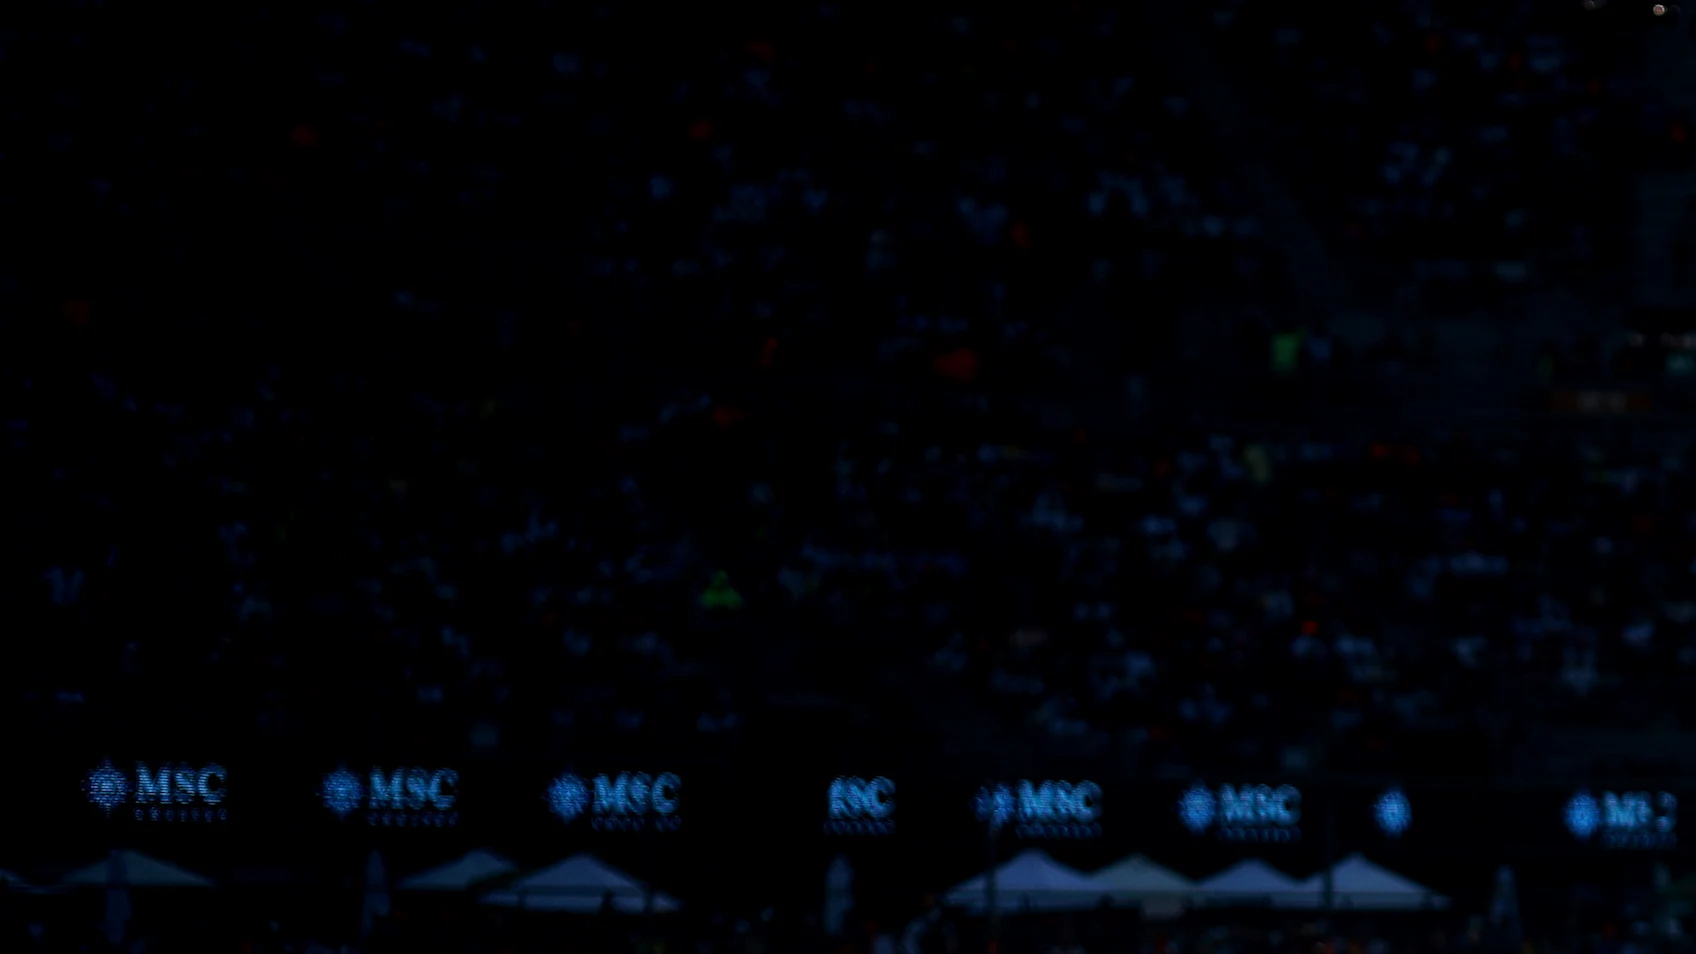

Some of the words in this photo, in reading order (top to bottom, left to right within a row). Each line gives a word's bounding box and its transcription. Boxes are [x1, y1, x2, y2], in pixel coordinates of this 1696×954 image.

[134, 760, 228, 805] MSC
[371, 765, 460, 810] MSC
[592, 771, 682, 816] MSC
[1016, 779, 1103, 822] MSC
[1218, 783, 1302, 826] MSC
